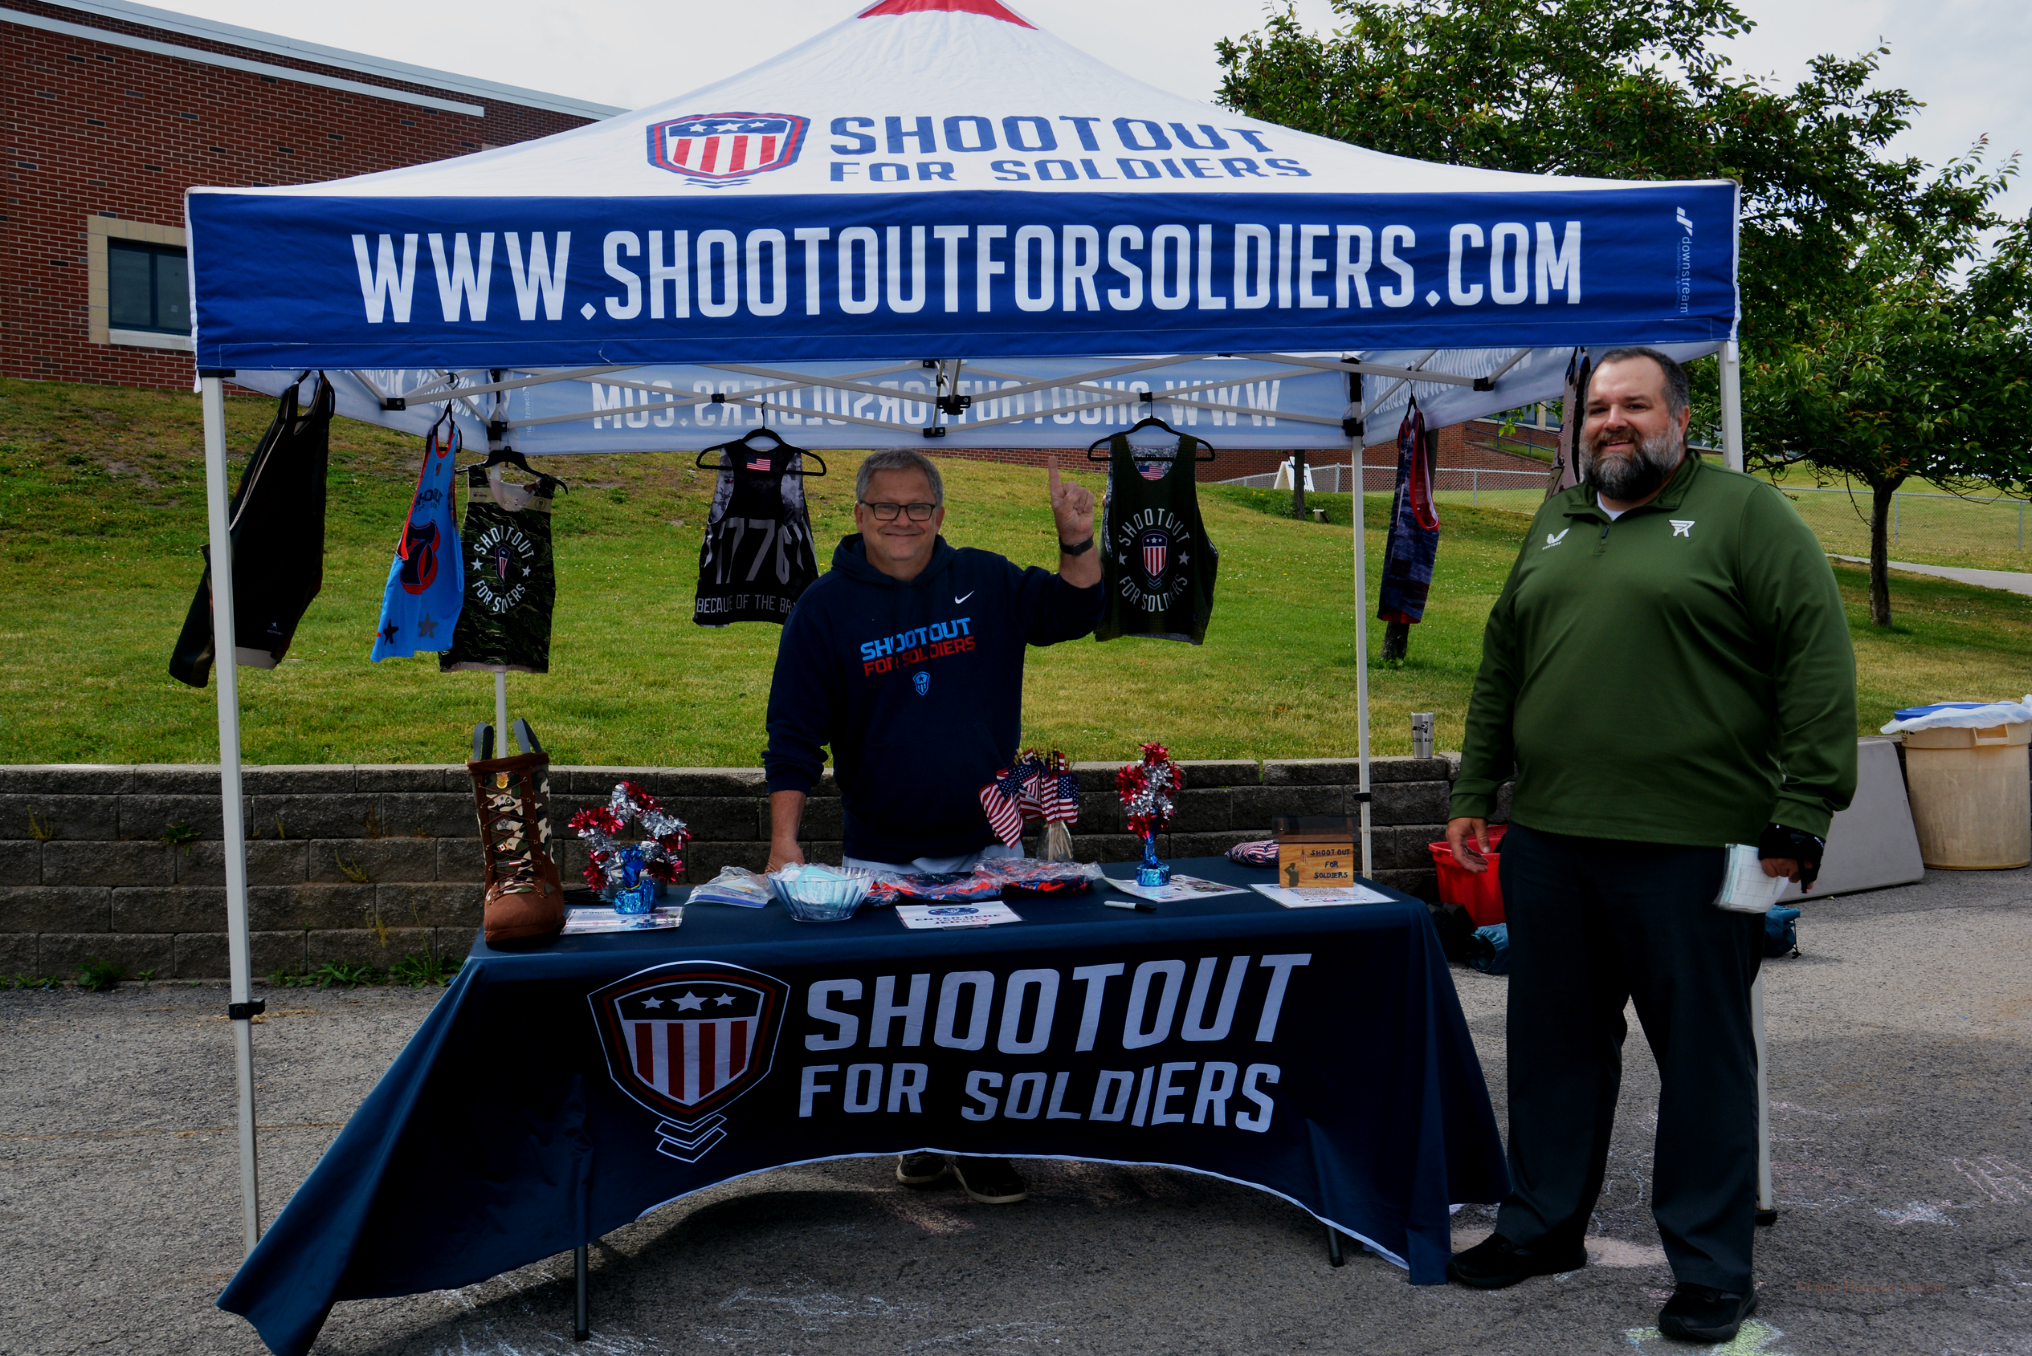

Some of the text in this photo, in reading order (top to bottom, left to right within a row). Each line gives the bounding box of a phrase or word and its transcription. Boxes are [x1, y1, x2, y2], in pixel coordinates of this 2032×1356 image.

[830, 114, 1273, 153] SHOOTOUT
[830, 157, 1312, 182] FOR SOLDIERS
[351, 221, 1582, 324] WWW.SHOOTOUTFORSOLDIERS.COM
[1680, 236, 1692, 313] downstream
[473, 525, 535, 559] SHOTOUT
[1118, 508, 1190, 547] SHOOTOUT
[471, 579, 493, 606] FOR
[696, 595, 734, 614] BECAUE
[735, 594, 750, 610] OF
[754, 594, 777, 611] THE
[1118, 575, 1141, 605] FOR
[860, 617, 971, 661] SHOOTOUT
[902, 636, 976, 667] SOLDIERS
[804, 953, 1312, 1054] SHOOTOUT
[798, 1061, 1281, 1133] FOR SOLDIERS
